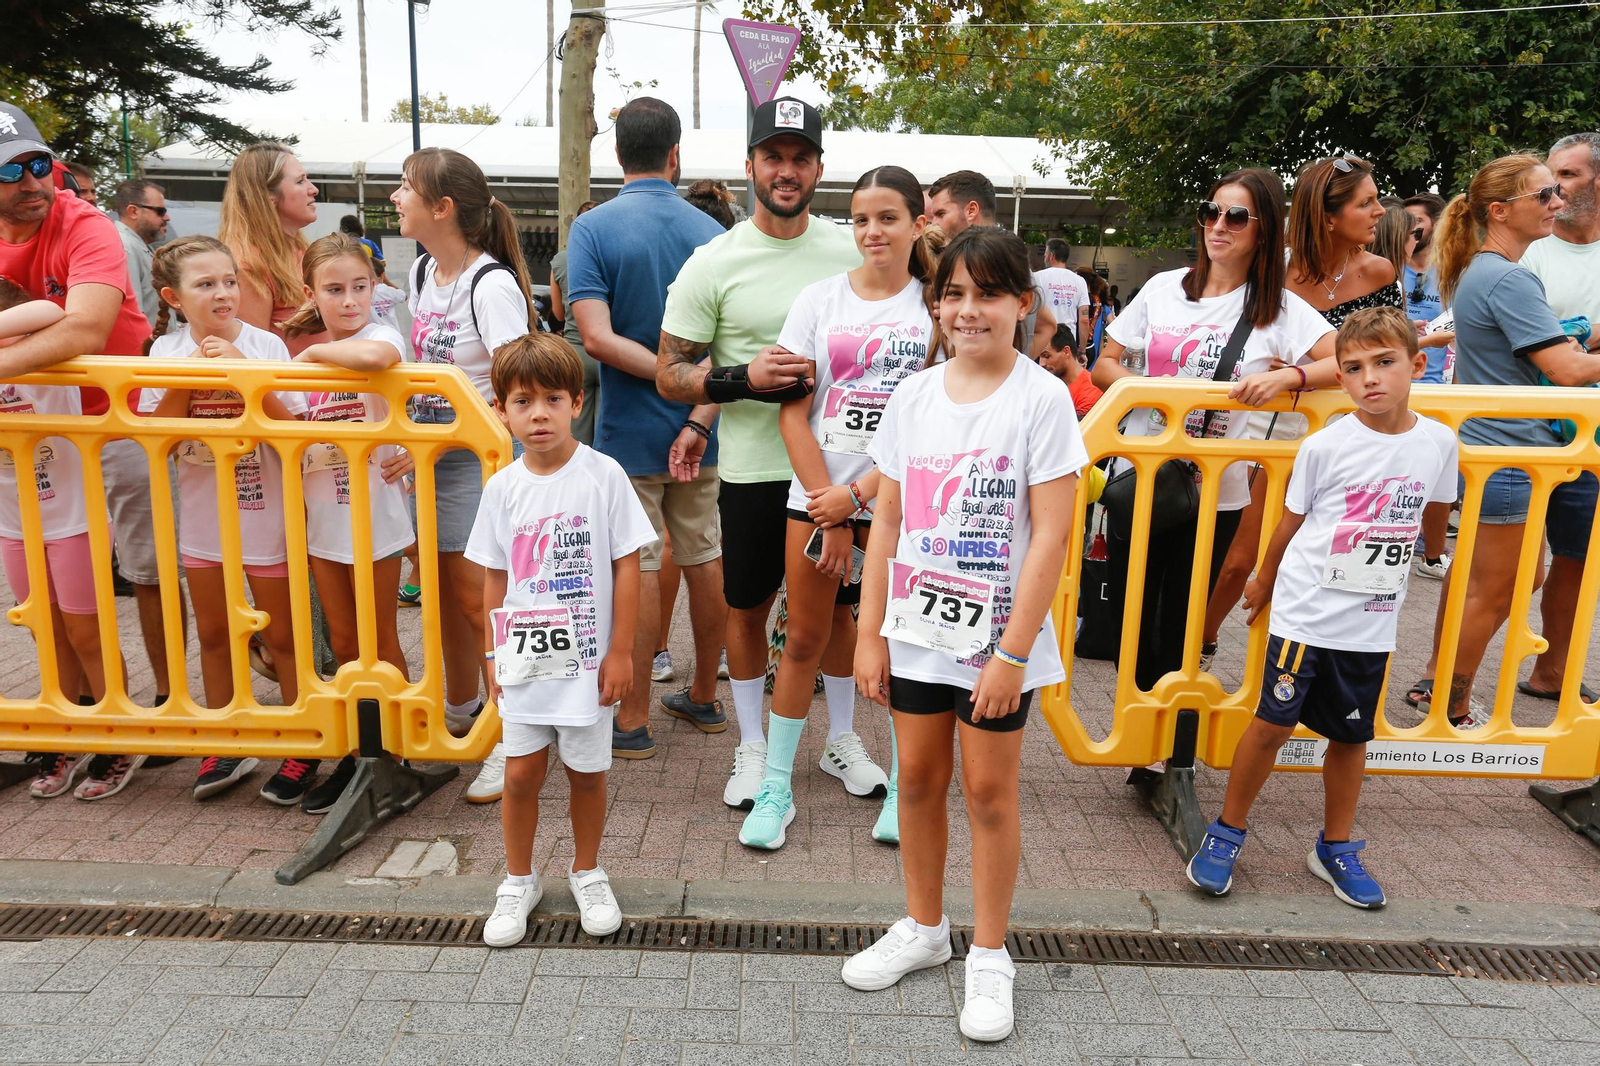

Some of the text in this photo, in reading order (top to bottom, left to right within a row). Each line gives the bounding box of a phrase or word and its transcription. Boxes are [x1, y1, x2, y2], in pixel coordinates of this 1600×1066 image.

[739, 30, 790, 44] CEDA EL PASO
[748, 48, 783, 72] Igualdad
[554, 515, 589, 535] AMOR
[960, 514, 1014, 531] FUERZA
[920, 536, 1010, 559] SONRISA
[1365, 544, 1413, 566] 795
[553, 560, 593, 570] FUERZA
[529, 576, 593, 594] SONRISA
[919, 590, 984, 628] 737
[513, 629, 571, 654] 736
[1432, 750, 1466, 764] Los
[1471, 752, 1539, 766] Barrios
